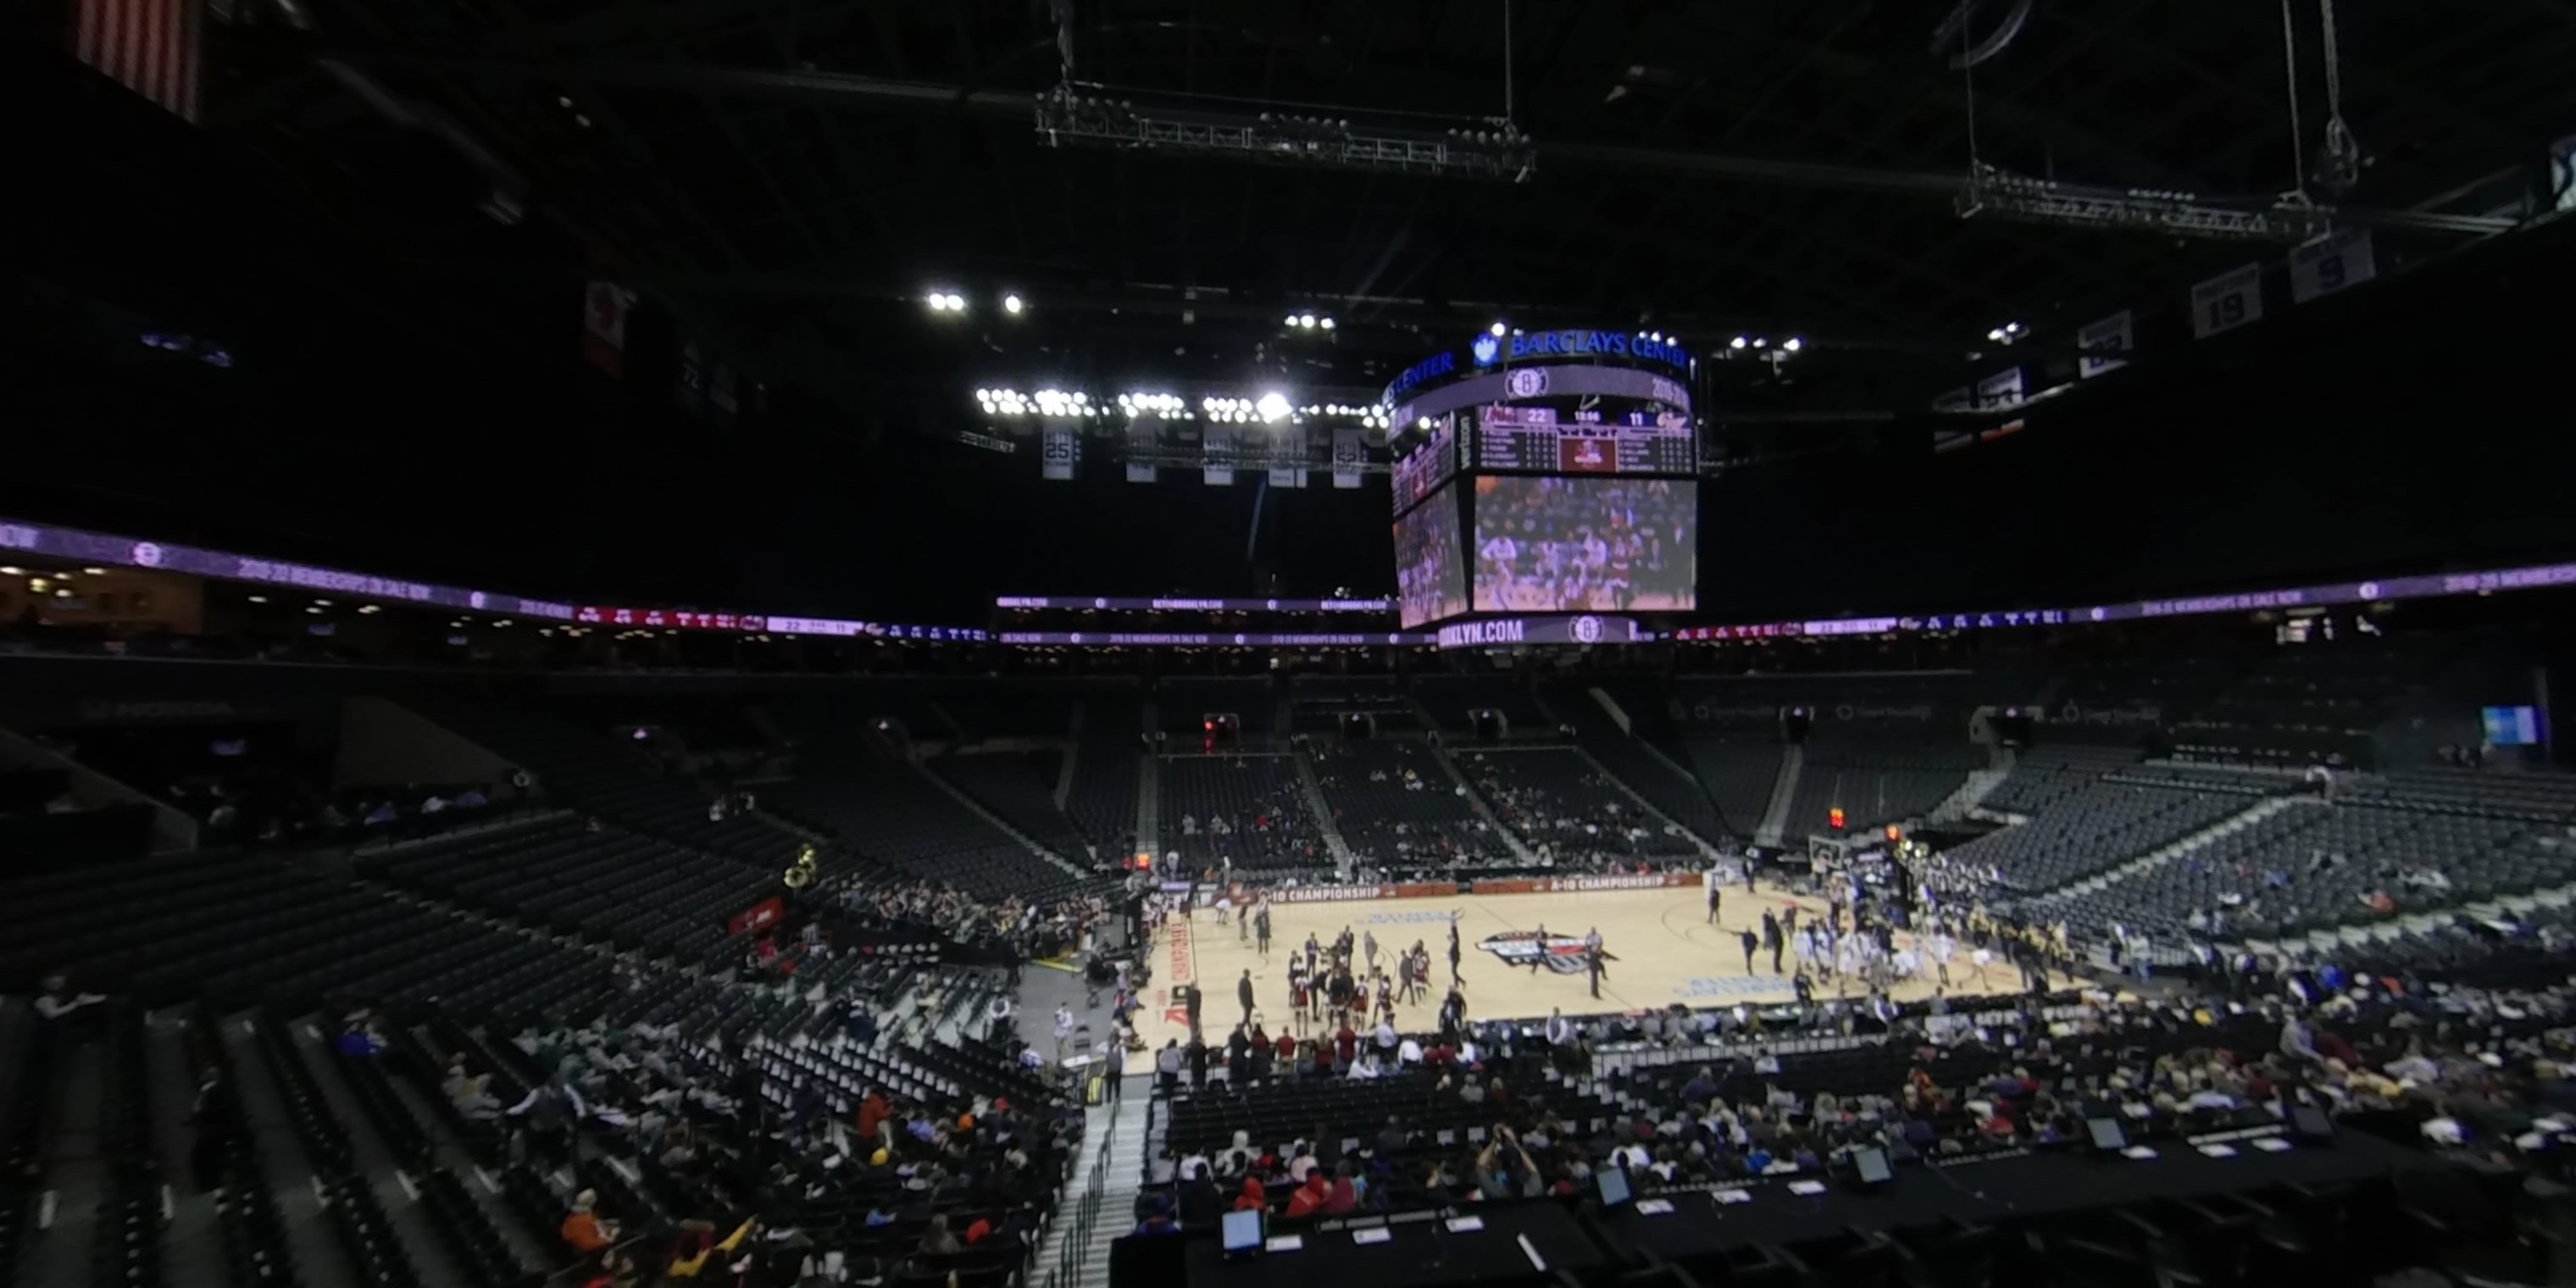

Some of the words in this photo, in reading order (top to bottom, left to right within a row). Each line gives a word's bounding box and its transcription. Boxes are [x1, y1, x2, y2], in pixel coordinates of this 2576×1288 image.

[1511, 330, 1626, 357] BARCLAYS
[1631, 336, 1687, 367] CENTER
[1395, 351, 1455, 393] CENTER
[1527, 408, 1546, 423] 22
[1629, 412, 1642, 426] 11
[1045, 443, 1069, 459] 25
[1458, 415, 1471, 471] verizon
[1551, 878, 1576, 891] A-10
[1578, 875, 1665, 889] CHAMPIONSHIP
[1288, 886, 1380, 901] CHAMPIONSHIP
